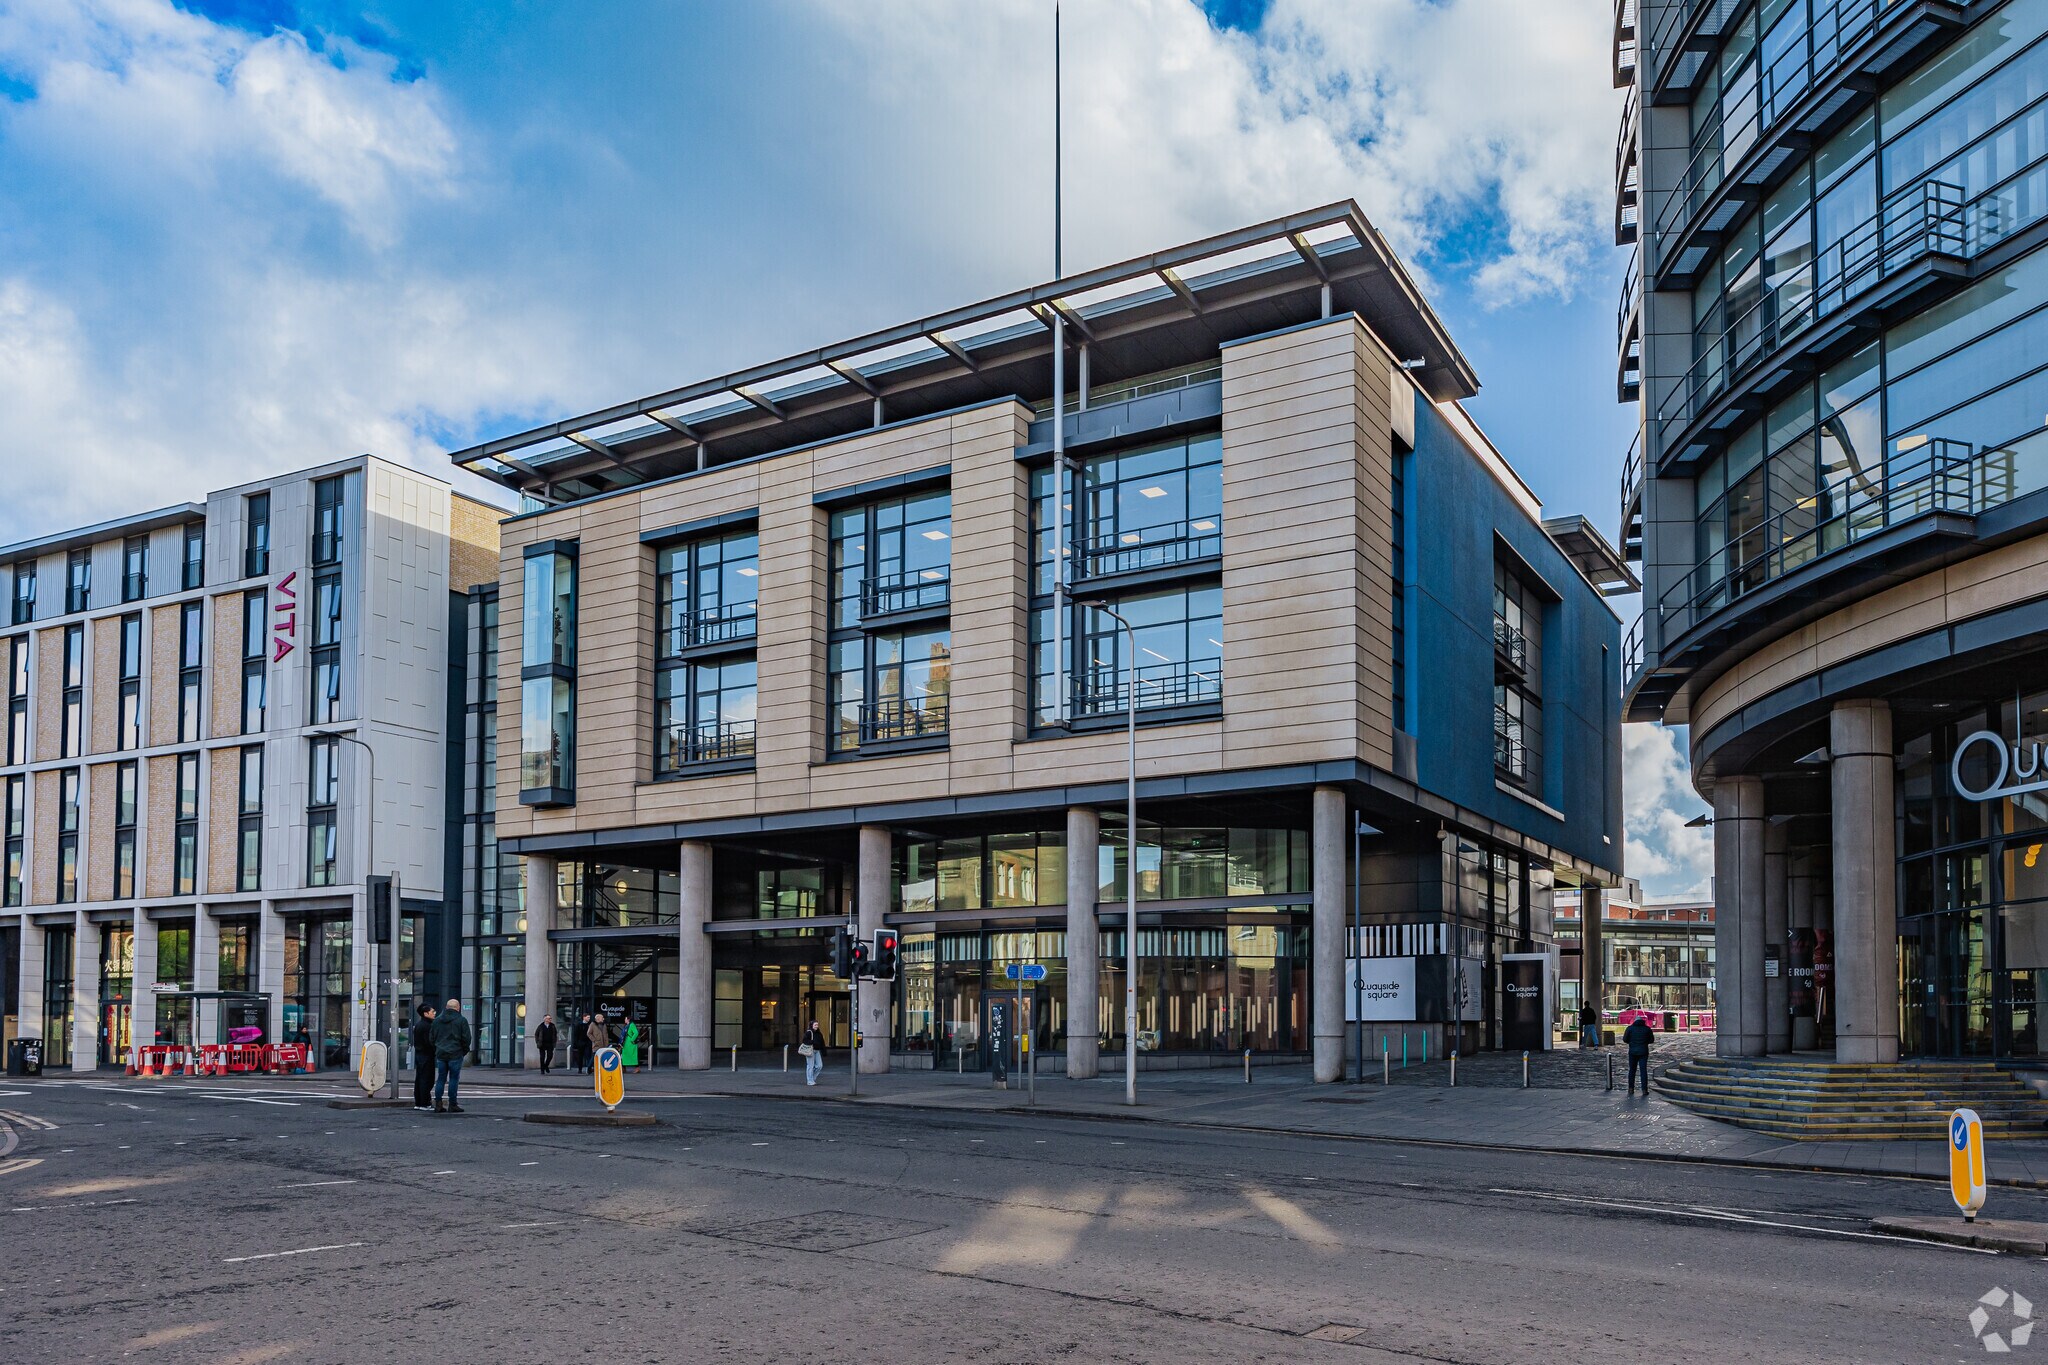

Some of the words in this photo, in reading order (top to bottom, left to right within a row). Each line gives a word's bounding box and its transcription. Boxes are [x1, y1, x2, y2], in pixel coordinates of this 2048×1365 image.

[274, 571, 297, 663] VITA
[1952, 730, 2048, 801] Qu
[1353, 979, 1400, 993] Quayside
[1506, 983, 1539, 995] Quayside
[1367, 992, 1398, 1001] square
[1516, 991, 1537, 999] square
[600, 1002, 626, 1012] Quayside
